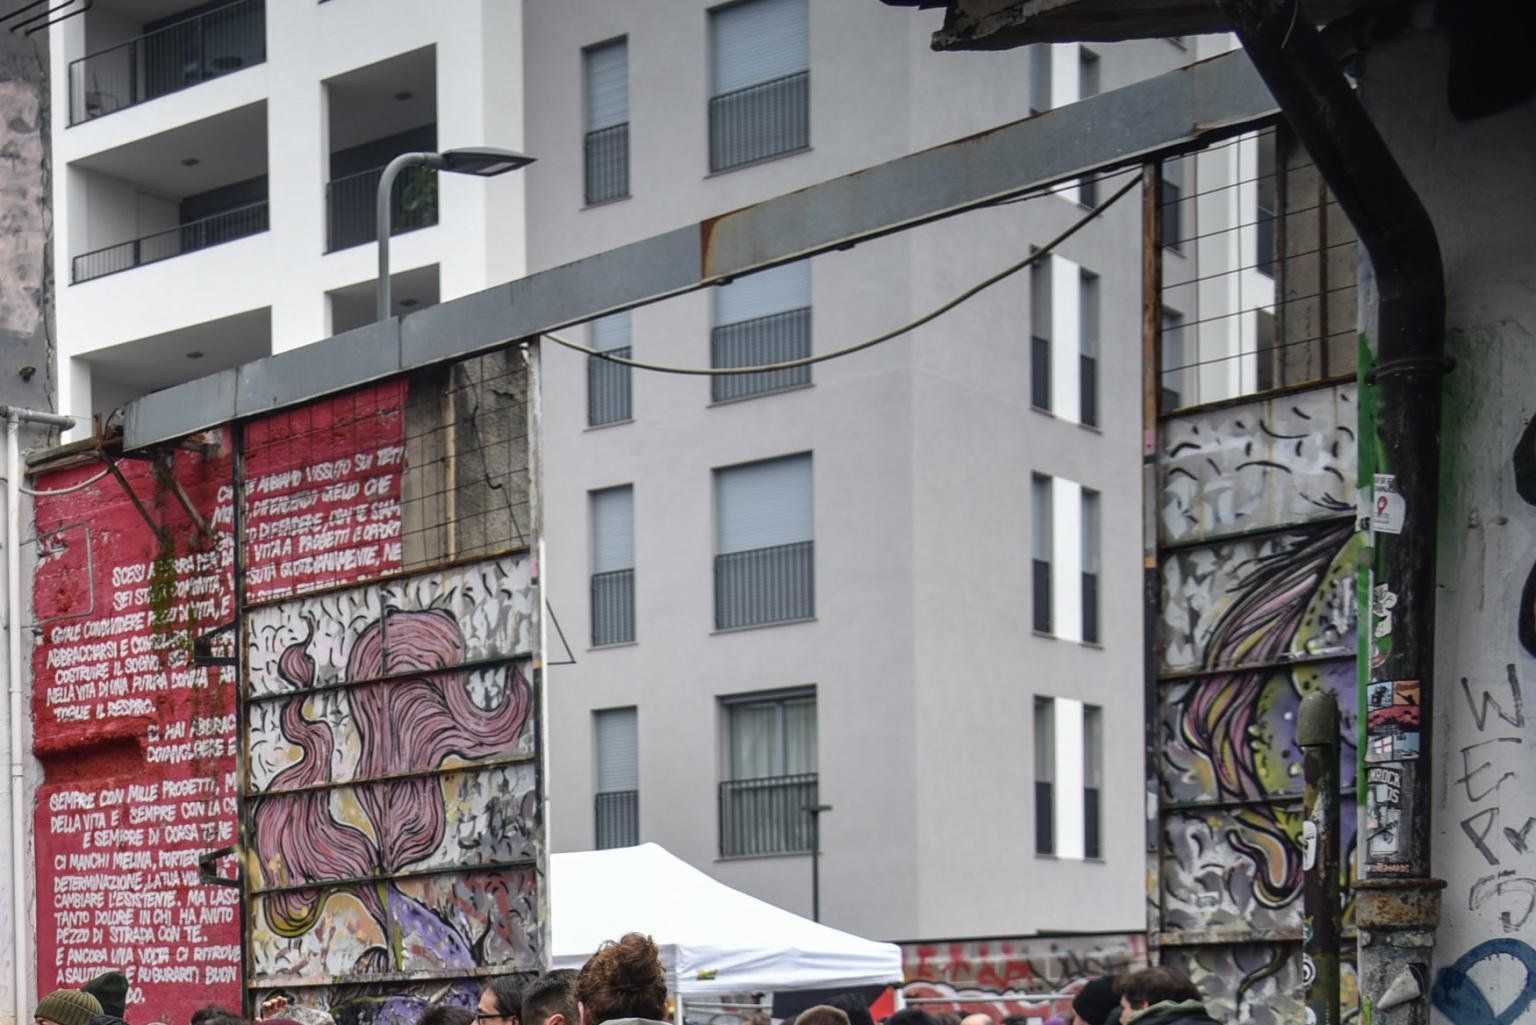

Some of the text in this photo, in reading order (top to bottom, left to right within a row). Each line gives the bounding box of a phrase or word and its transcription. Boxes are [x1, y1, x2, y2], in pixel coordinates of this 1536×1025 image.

[49, 792, 96, 813] SEMPRE
[99, 788, 125, 807] CON
[127, 783, 159, 803] MILLE
[50, 814, 82, 834] DELLA
[82, 812, 106, 831] VITA
[111, 810, 120, 827] E
[129, 804, 177, 825] SEMPRE
[181, 801, 206, 819] CON
[83, 831, 91, 849] E
[94, 828, 144, 848] SEMPRE
[54, 854, 67, 870] CI
[54, 891, 104, 909] CAMBIARE
[187, 889, 206, 907] MA
[54, 910, 90, 928] TANTO
[139, 910, 151, 926] IN
[179, 907, 198, 925] HA
[92, 927, 104, 945] DI
[157, 925, 181, 942] CON
[55, 947, 64, 967] E
[111, 947, 134, 965] UNA
